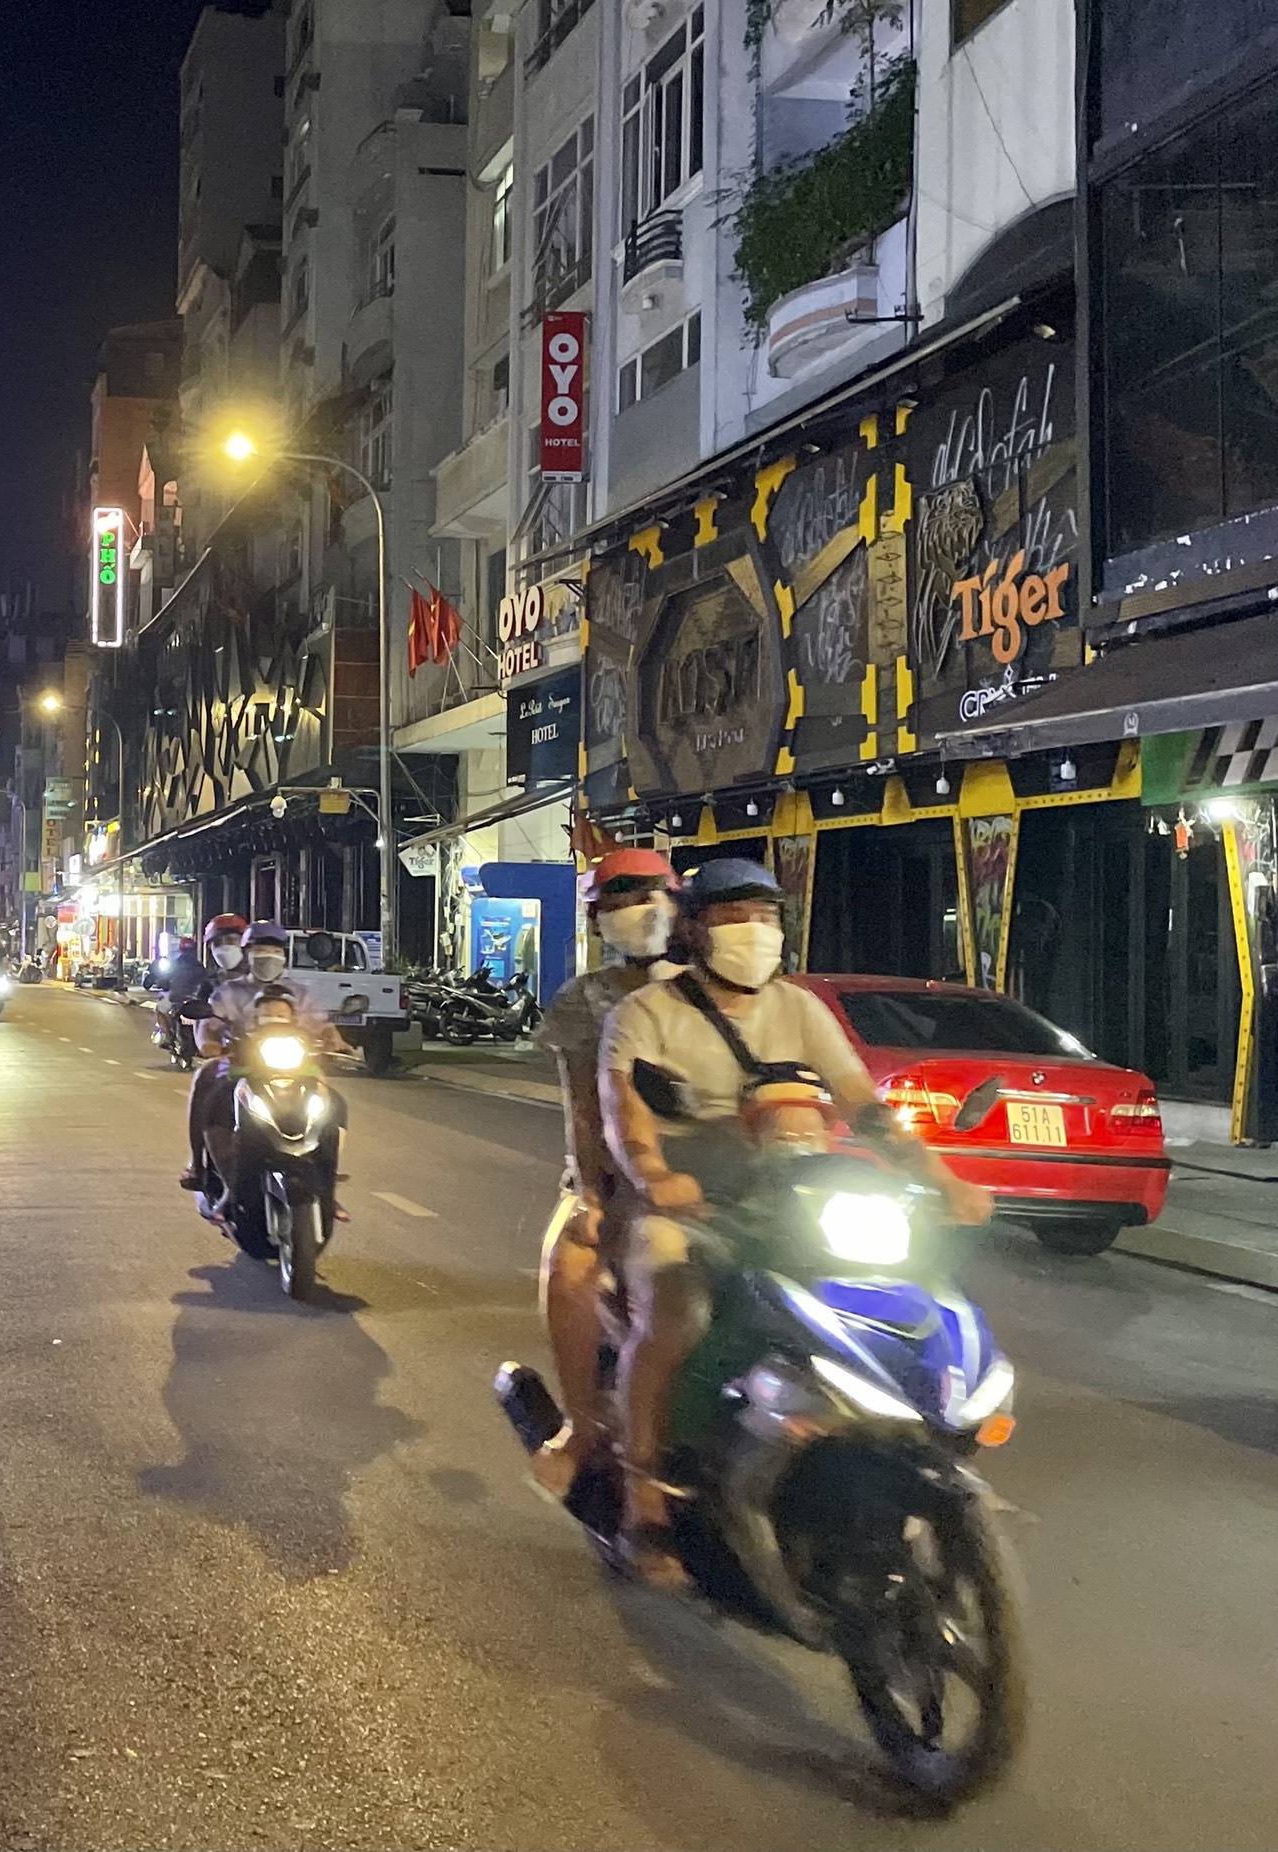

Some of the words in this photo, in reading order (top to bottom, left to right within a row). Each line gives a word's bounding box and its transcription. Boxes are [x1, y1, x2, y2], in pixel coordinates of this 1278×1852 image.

[548, 333, 579, 426] OYO
[545, 438, 580, 447] HOTEL
[499, 585, 542, 642] OYO
[951, 549, 1069, 664] Tiger
[498, 642, 538, 680] HOTEL
[531, 723, 559, 745] HOTEL
[46, 819, 57, 856] OTEL
[1013, 1124, 1061, 1142] 611.11
[1021, 1106, 1051, 1124] 51A
